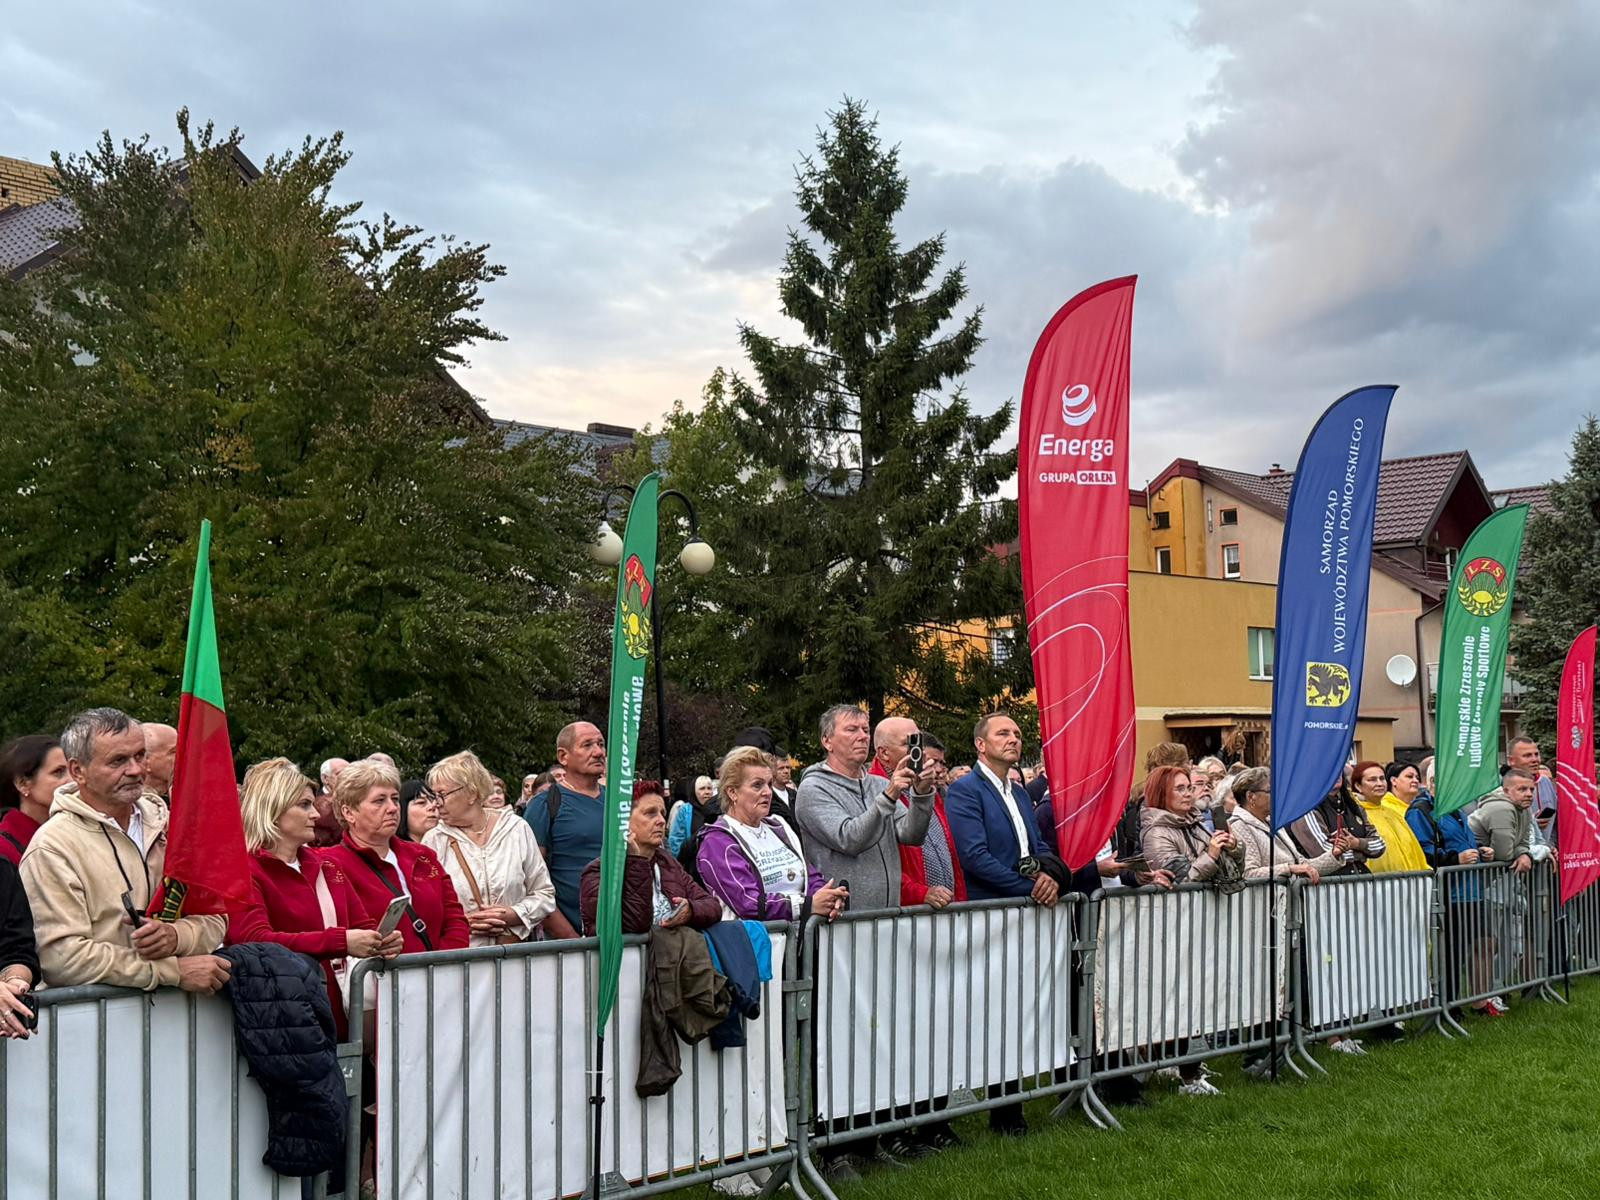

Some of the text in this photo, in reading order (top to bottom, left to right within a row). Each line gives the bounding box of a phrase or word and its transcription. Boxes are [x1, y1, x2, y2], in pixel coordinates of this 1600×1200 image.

[1038, 433, 1114, 462] Energa
[1039, 472, 1114, 483] GRUPA ORLEN
[1319, 489, 1339, 575] SAMORZĄD
[1332, 417, 1364, 654] WOJEWÓDZTWA POMORSKIEGO
[1459, 635, 1476, 695] Zrzeszenie
[1468, 725, 1483, 768] Ludowe
[1476, 625, 1491, 679] Sportowe
